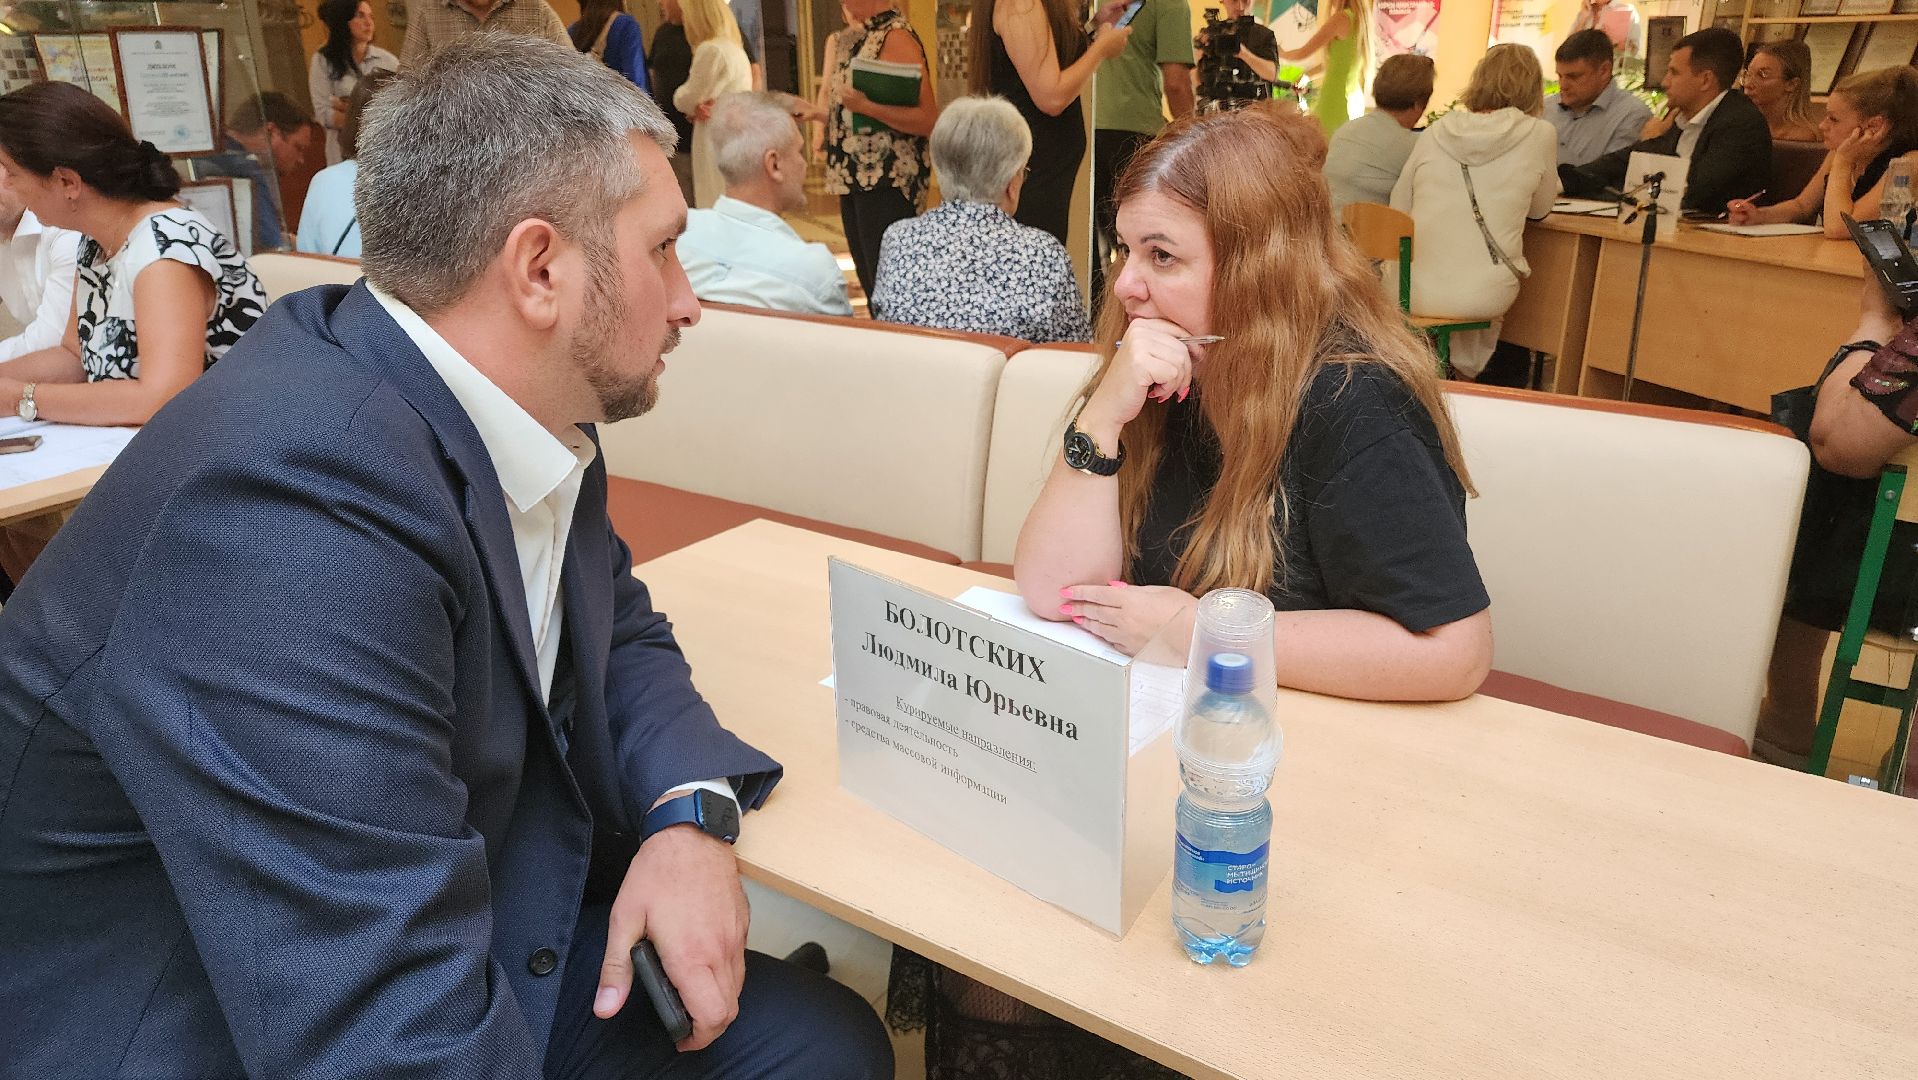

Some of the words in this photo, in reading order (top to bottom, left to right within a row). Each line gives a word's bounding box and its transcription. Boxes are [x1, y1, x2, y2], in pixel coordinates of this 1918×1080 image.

[884, 599, 1047, 684] БОЛОТСКИХ
[861, 631, 959, 691] Людмила
[964, 672, 1079, 741] Юрьевна
[895, 696, 960, 735] Курируемые
[850, 698, 891, 726] правовая
[893, 715, 960, 758] деятельность
[850, 719, 891, 746] средства
[892, 736, 938, 770] массовой
